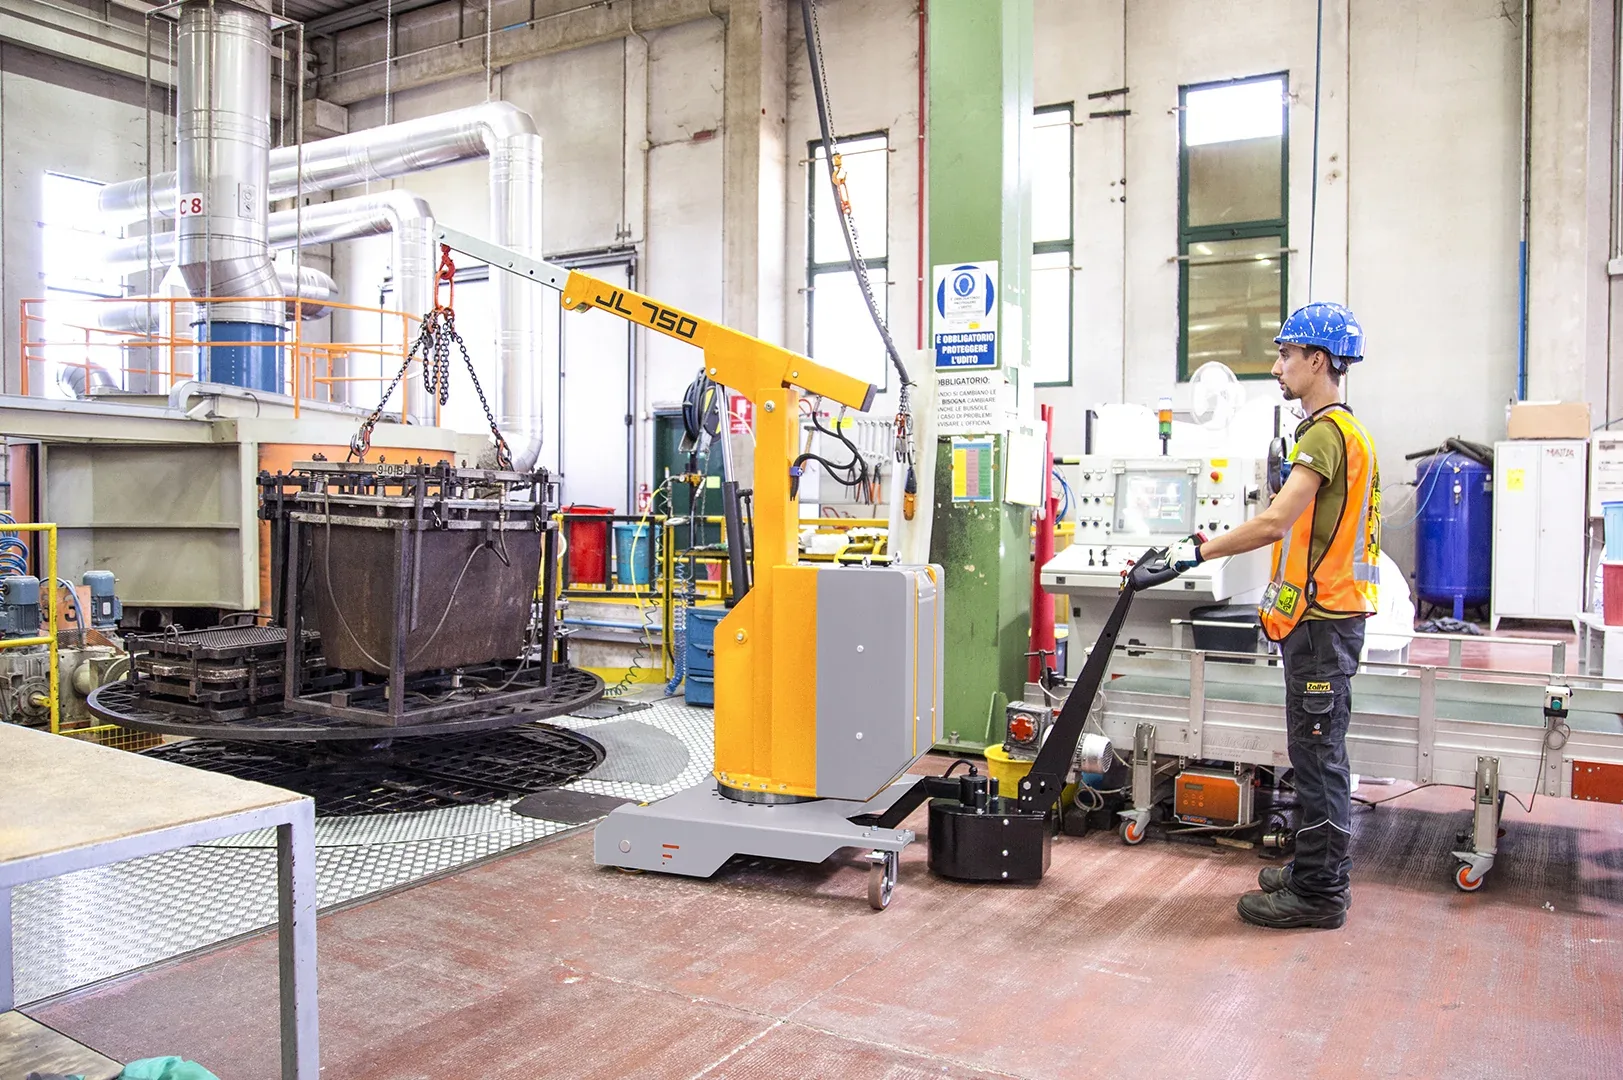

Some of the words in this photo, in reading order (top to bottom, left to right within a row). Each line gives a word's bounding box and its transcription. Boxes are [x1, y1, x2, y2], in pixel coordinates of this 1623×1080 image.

[180, 199, 187, 215] C
[191, 198, 202, 214] 8
[595, 290, 632, 316] JL
[642, 301, 698, 339] 750
[942, 333, 994, 344] OBBLIGATORIO
[942, 344, 988, 354] PROTEGGERE
[951, 355, 978, 365] L'UDITO
[959, 389, 989, 397] CAMBIANO
